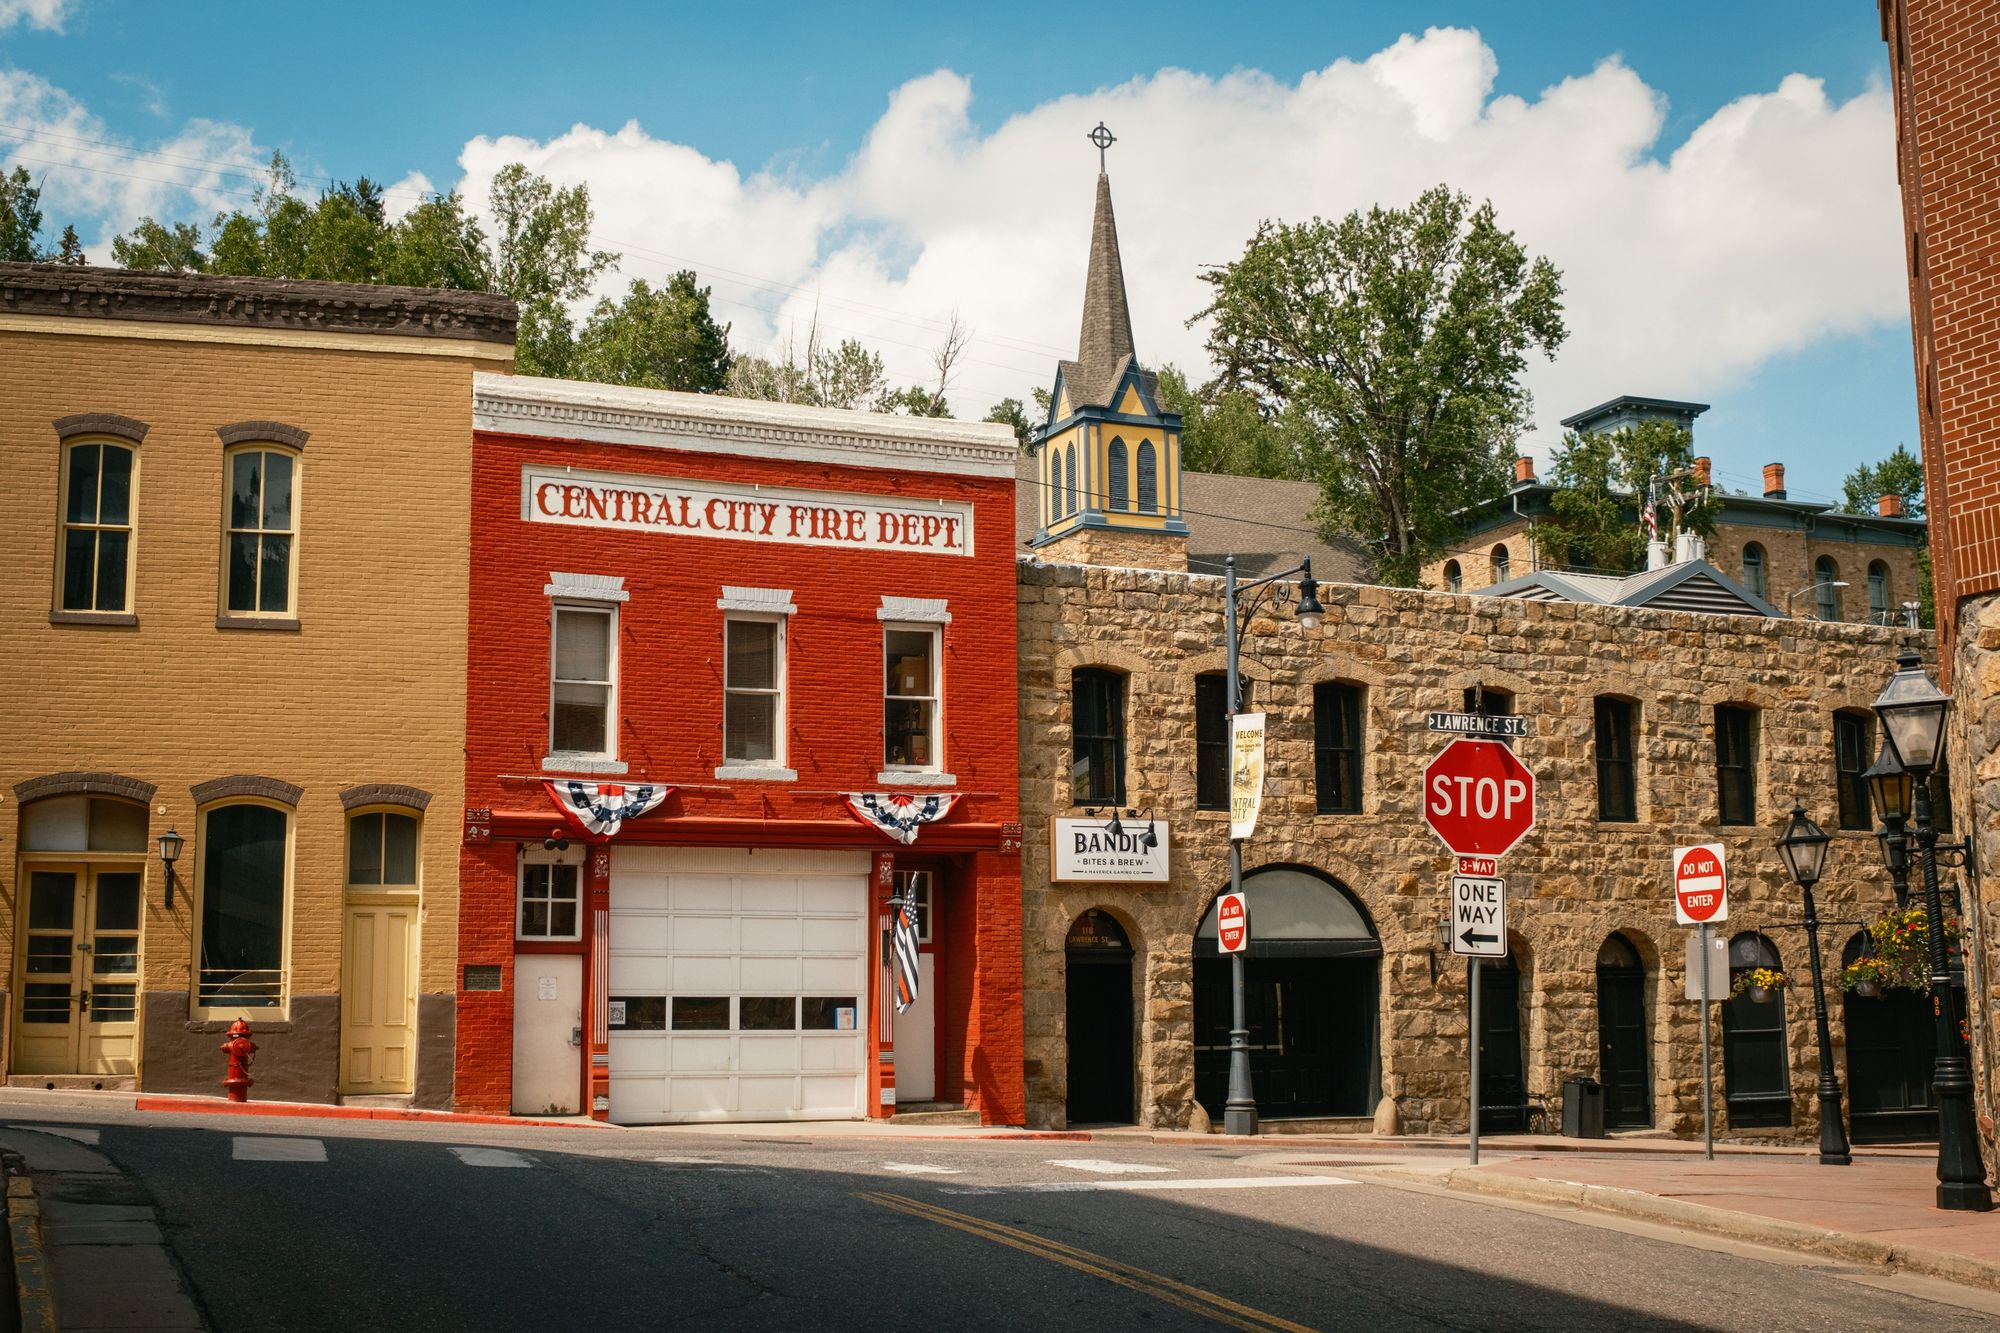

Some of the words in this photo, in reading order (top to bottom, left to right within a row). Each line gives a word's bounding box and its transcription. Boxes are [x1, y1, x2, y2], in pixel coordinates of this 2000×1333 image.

[535, 482, 700, 528] CENTRAL
[704, 497, 779, 536] CITY
[786, 508, 866, 542] FIRE
[876, 511, 963, 548] DEPT.
[1436, 714, 1499, 732] LAWRENCE
[1504, 718, 1519, 734] ST
[1235, 729, 1262, 740] WELCOME
[1232, 797, 1256, 808] NTRAL
[1430, 773, 1527, 820] STOP
[1082, 858, 1107, 866] BITES
[1109, 858, 1115, 866] &
[1117, 858, 1144, 867] BREW
[1460, 859, 1495, 874] 3-WAY
[1683, 862, 1695, 875] DO
[1697, 860, 1714, 874] NOT
[1458, 883, 1498, 903] ONE
[1687, 894, 1714, 908] ENTER
[1222, 907, 1230, 916] DO
[1230, 905, 1240, 915] NOT
[1458, 904, 1497, 925] WAY
[1224, 931, 1240, 941] ENTER
